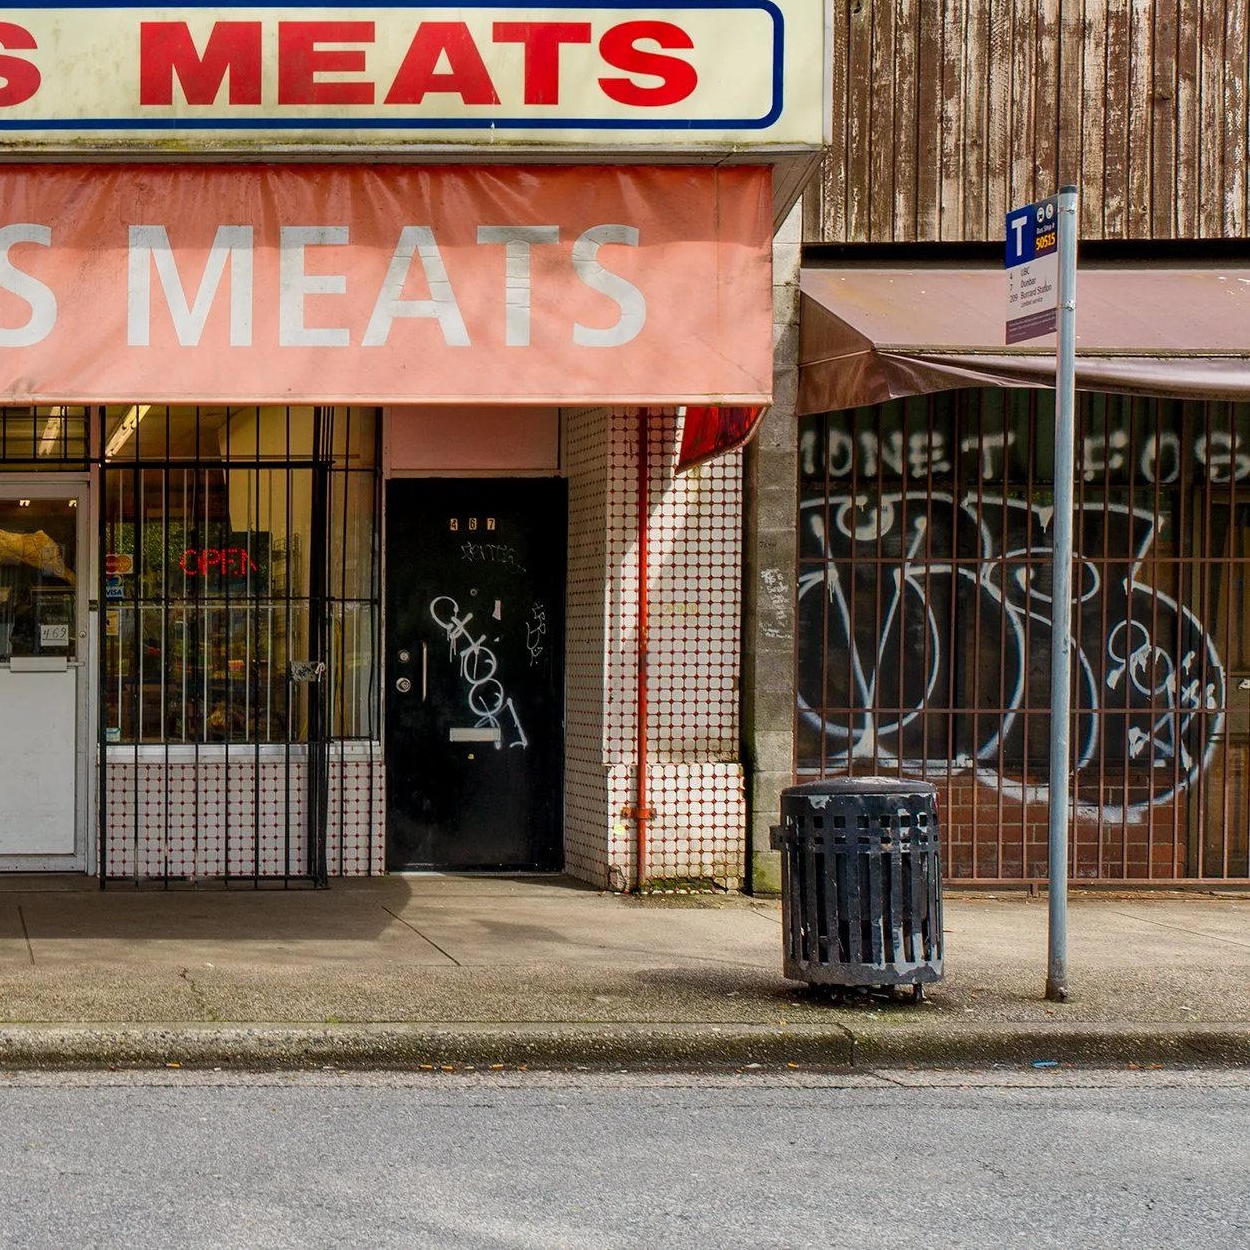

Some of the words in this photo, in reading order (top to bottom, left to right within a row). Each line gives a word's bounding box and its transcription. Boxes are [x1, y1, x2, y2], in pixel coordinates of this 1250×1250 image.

[140, 20, 698, 107] MEATS
[1036, 232, 1056, 250] 50515
[1021, 266, 1030, 277] UBC
[127, 224, 647, 347] MEATS
[1009, 283, 1013, 292] 7
[1021, 277, 1036, 288] Dunbar
[1009, 293, 1018, 303] 209
[1021, 288, 1036, 300] Burrard
[1037, 284, 1052, 295] Station
[179, 548, 258, 576] OPEN
[42, 626, 67, 640] 469
